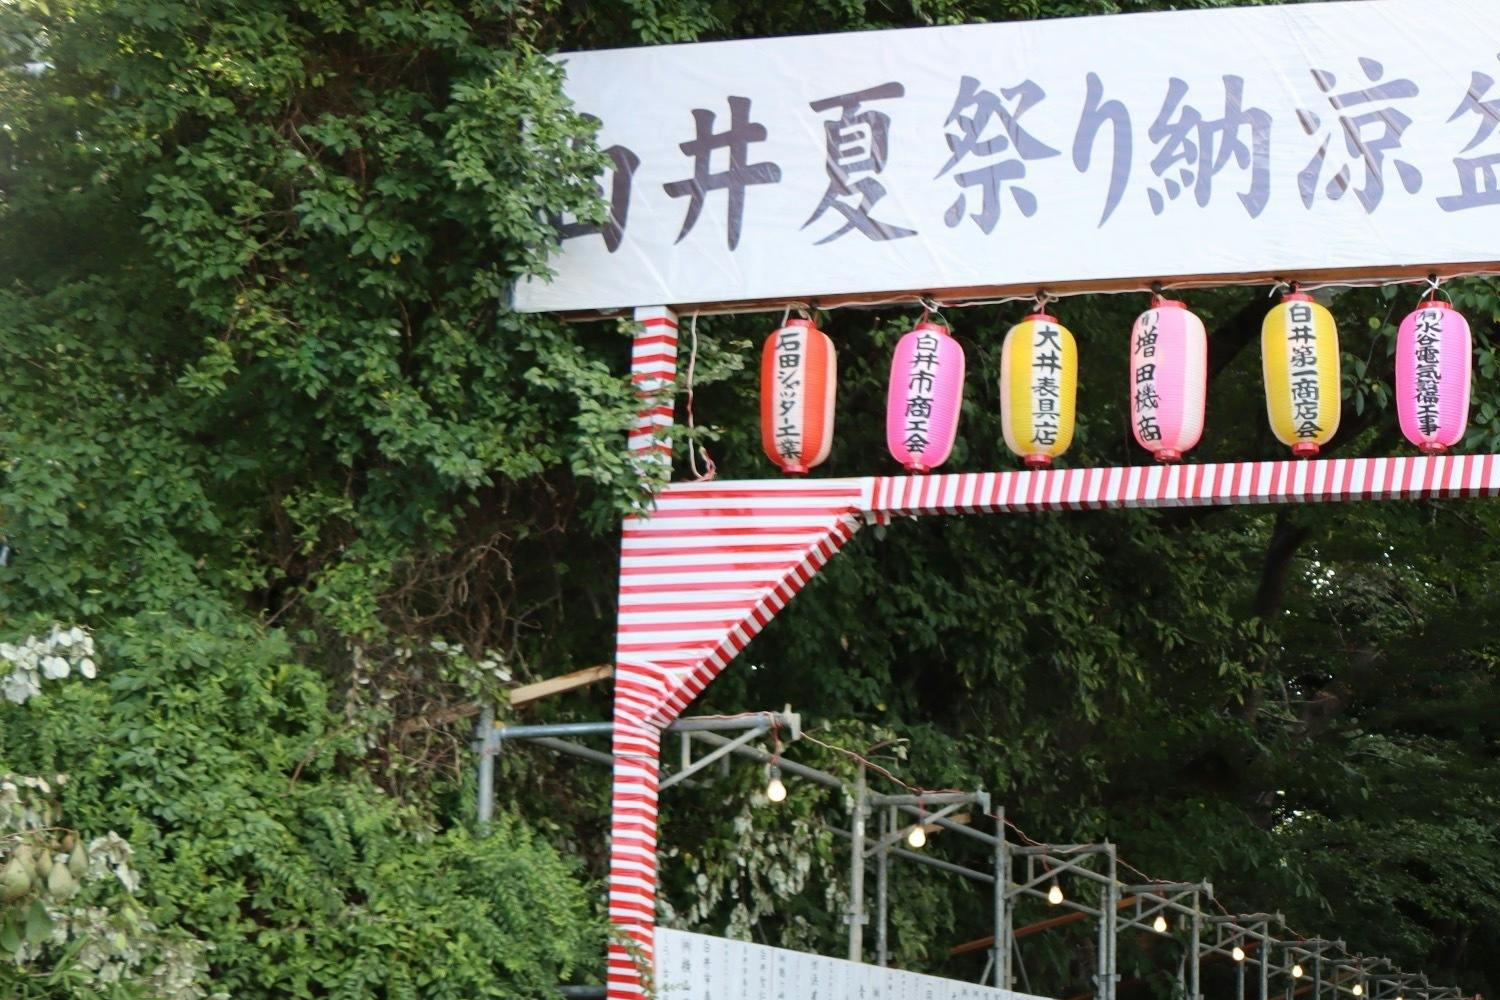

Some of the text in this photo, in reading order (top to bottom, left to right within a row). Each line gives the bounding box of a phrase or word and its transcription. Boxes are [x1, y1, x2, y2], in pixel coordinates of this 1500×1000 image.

[775, 332, 801, 458] 石田シャッター工業
[903, 334, 940, 454] 白井市商工会
[1030, 325, 1063, 446] 大井表具店
[1287, 303, 1324, 438] 白井第一商店会
